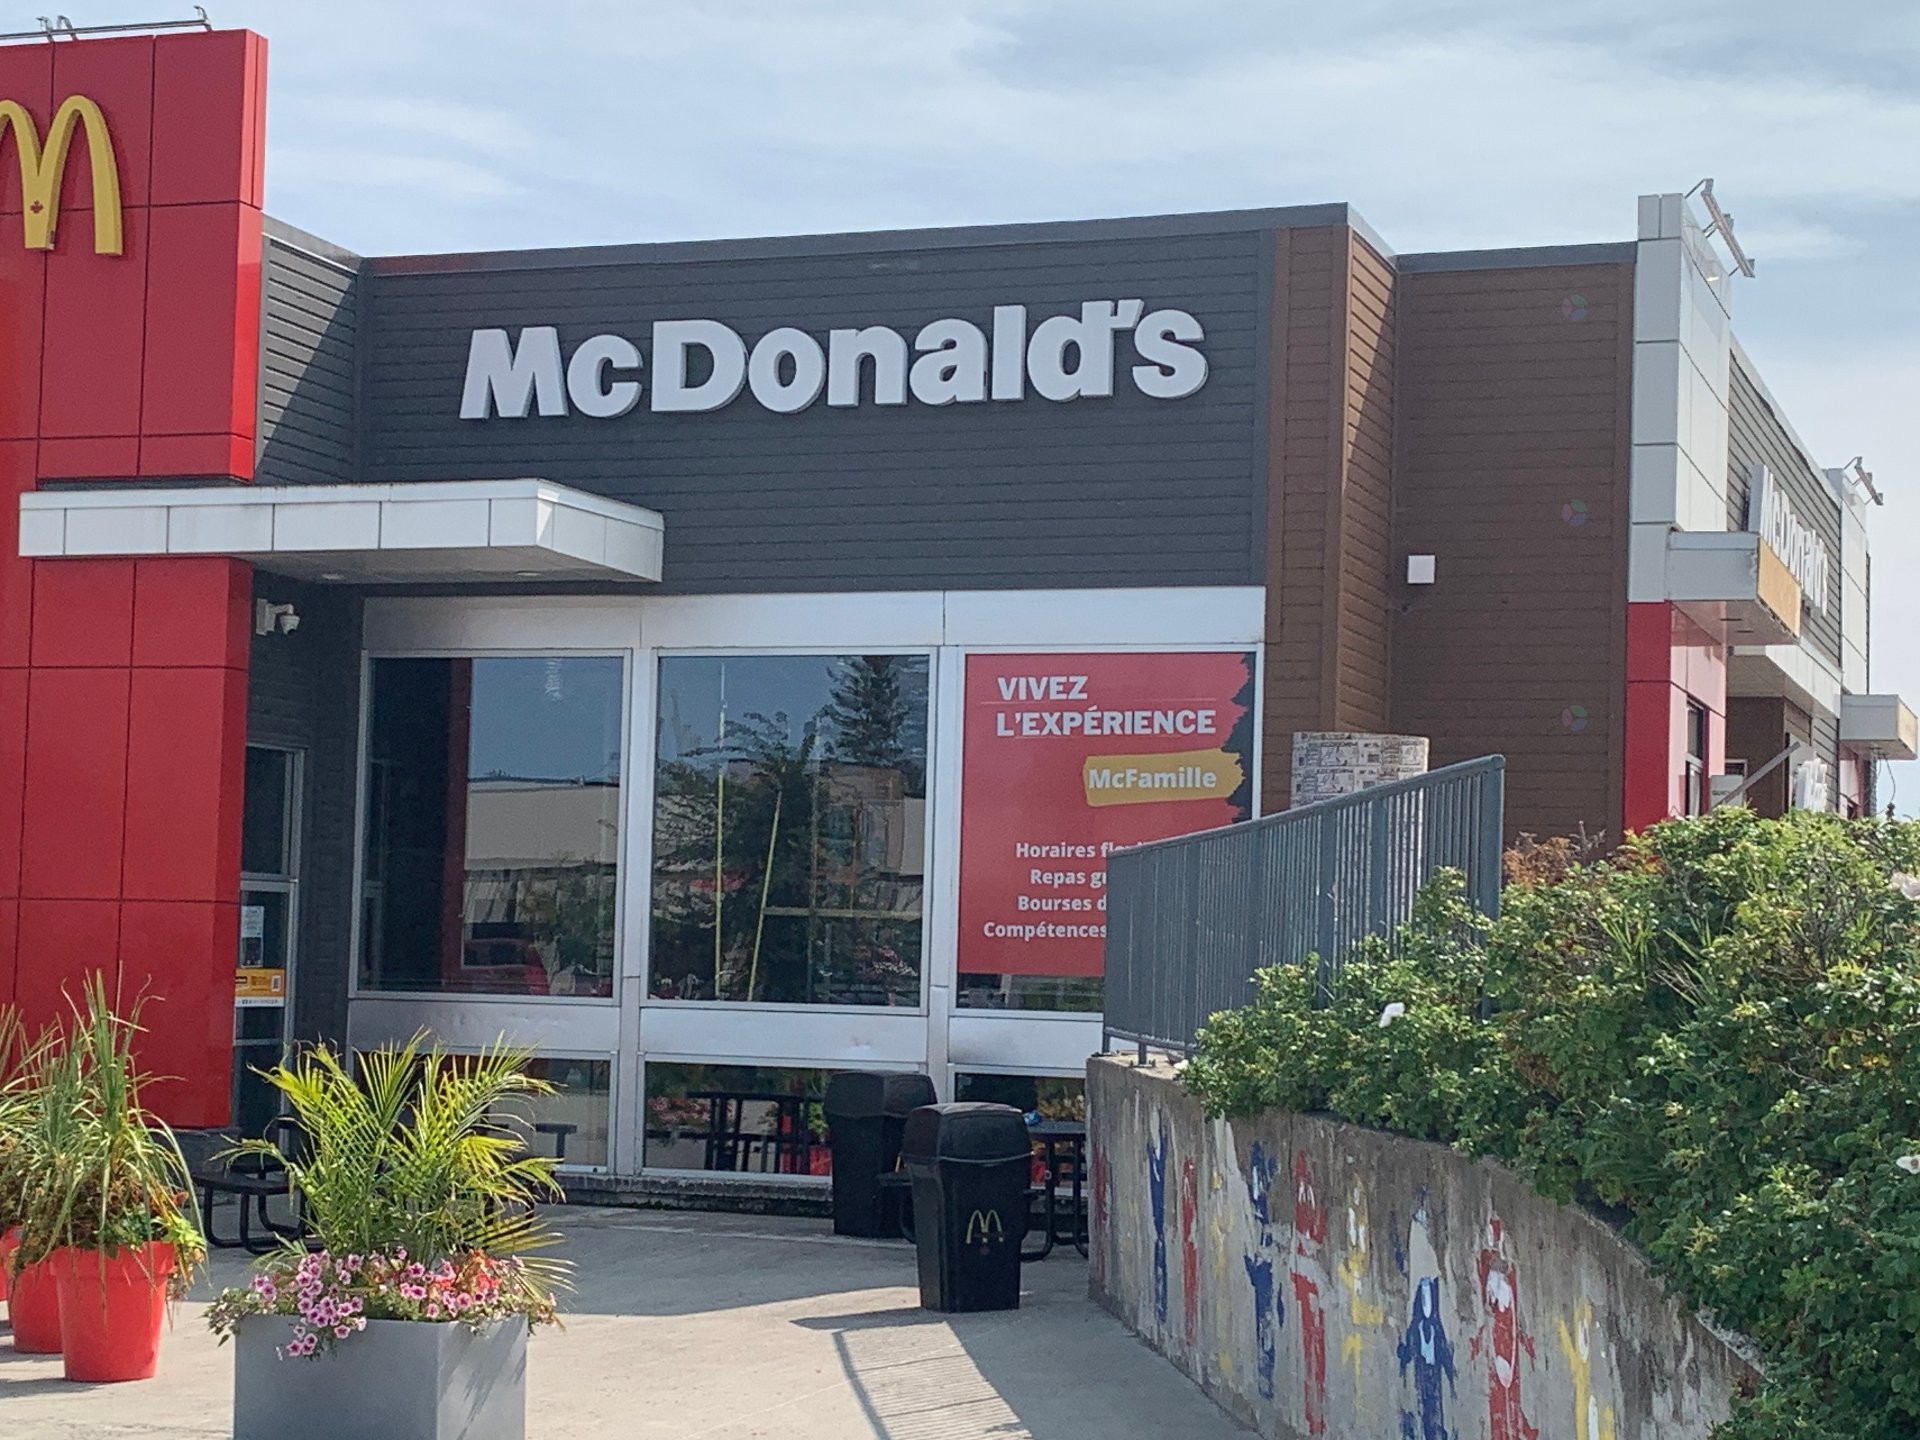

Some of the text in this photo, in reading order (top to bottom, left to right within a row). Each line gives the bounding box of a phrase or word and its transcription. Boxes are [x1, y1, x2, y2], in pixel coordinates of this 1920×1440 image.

[459, 299, 1208, 420] McDonald's
[997, 675, 1088, 701] VIVEZ
[996, 704, 1217, 737] L'EXPÉRIENCE
[1088, 766, 1217, 789] McFamille
[1015, 842, 1096, 858] Horaires
[1030, 869, 1086, 889] Repas
[1017, 895, 1092, 912] Bourses
[983, 921, 1107, 942] Compétences
